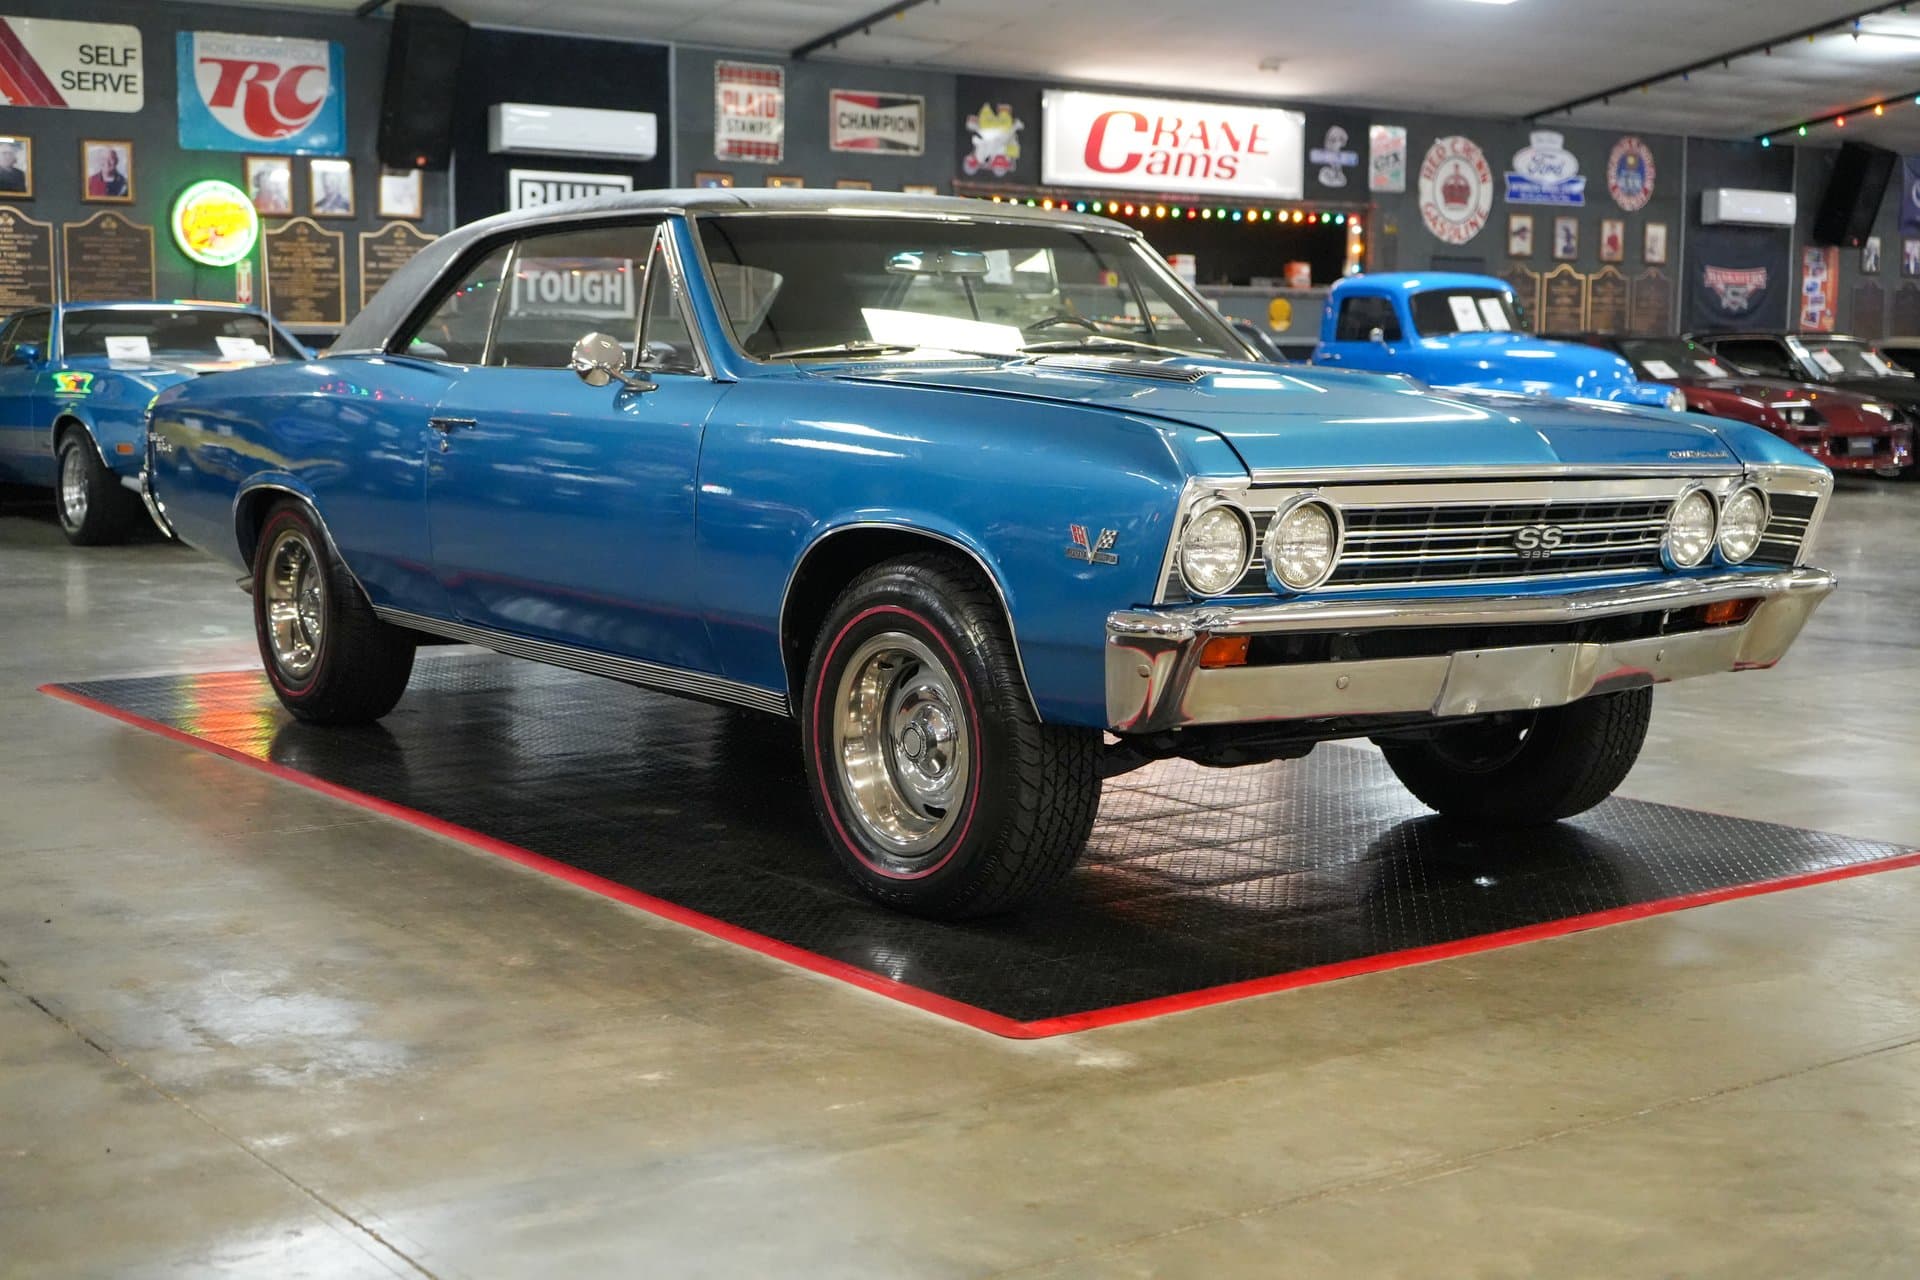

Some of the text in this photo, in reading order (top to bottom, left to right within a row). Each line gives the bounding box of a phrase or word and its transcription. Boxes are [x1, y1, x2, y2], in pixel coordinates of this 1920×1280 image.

[79, 44, 137, 67] SELF
[60, 70, 138, 94] SERVE
[200, 57, 326, 138] RC
[723, 90, 777, 118] PLAID
[726, 119, 773, 135] STAMPS
[838, 111, 917, 133] CHAMPION
[526, 270, 622, 305] TOUGH
[1515, 527, 1562, 550] SS
[1521, 550, 1551, 559] 396
